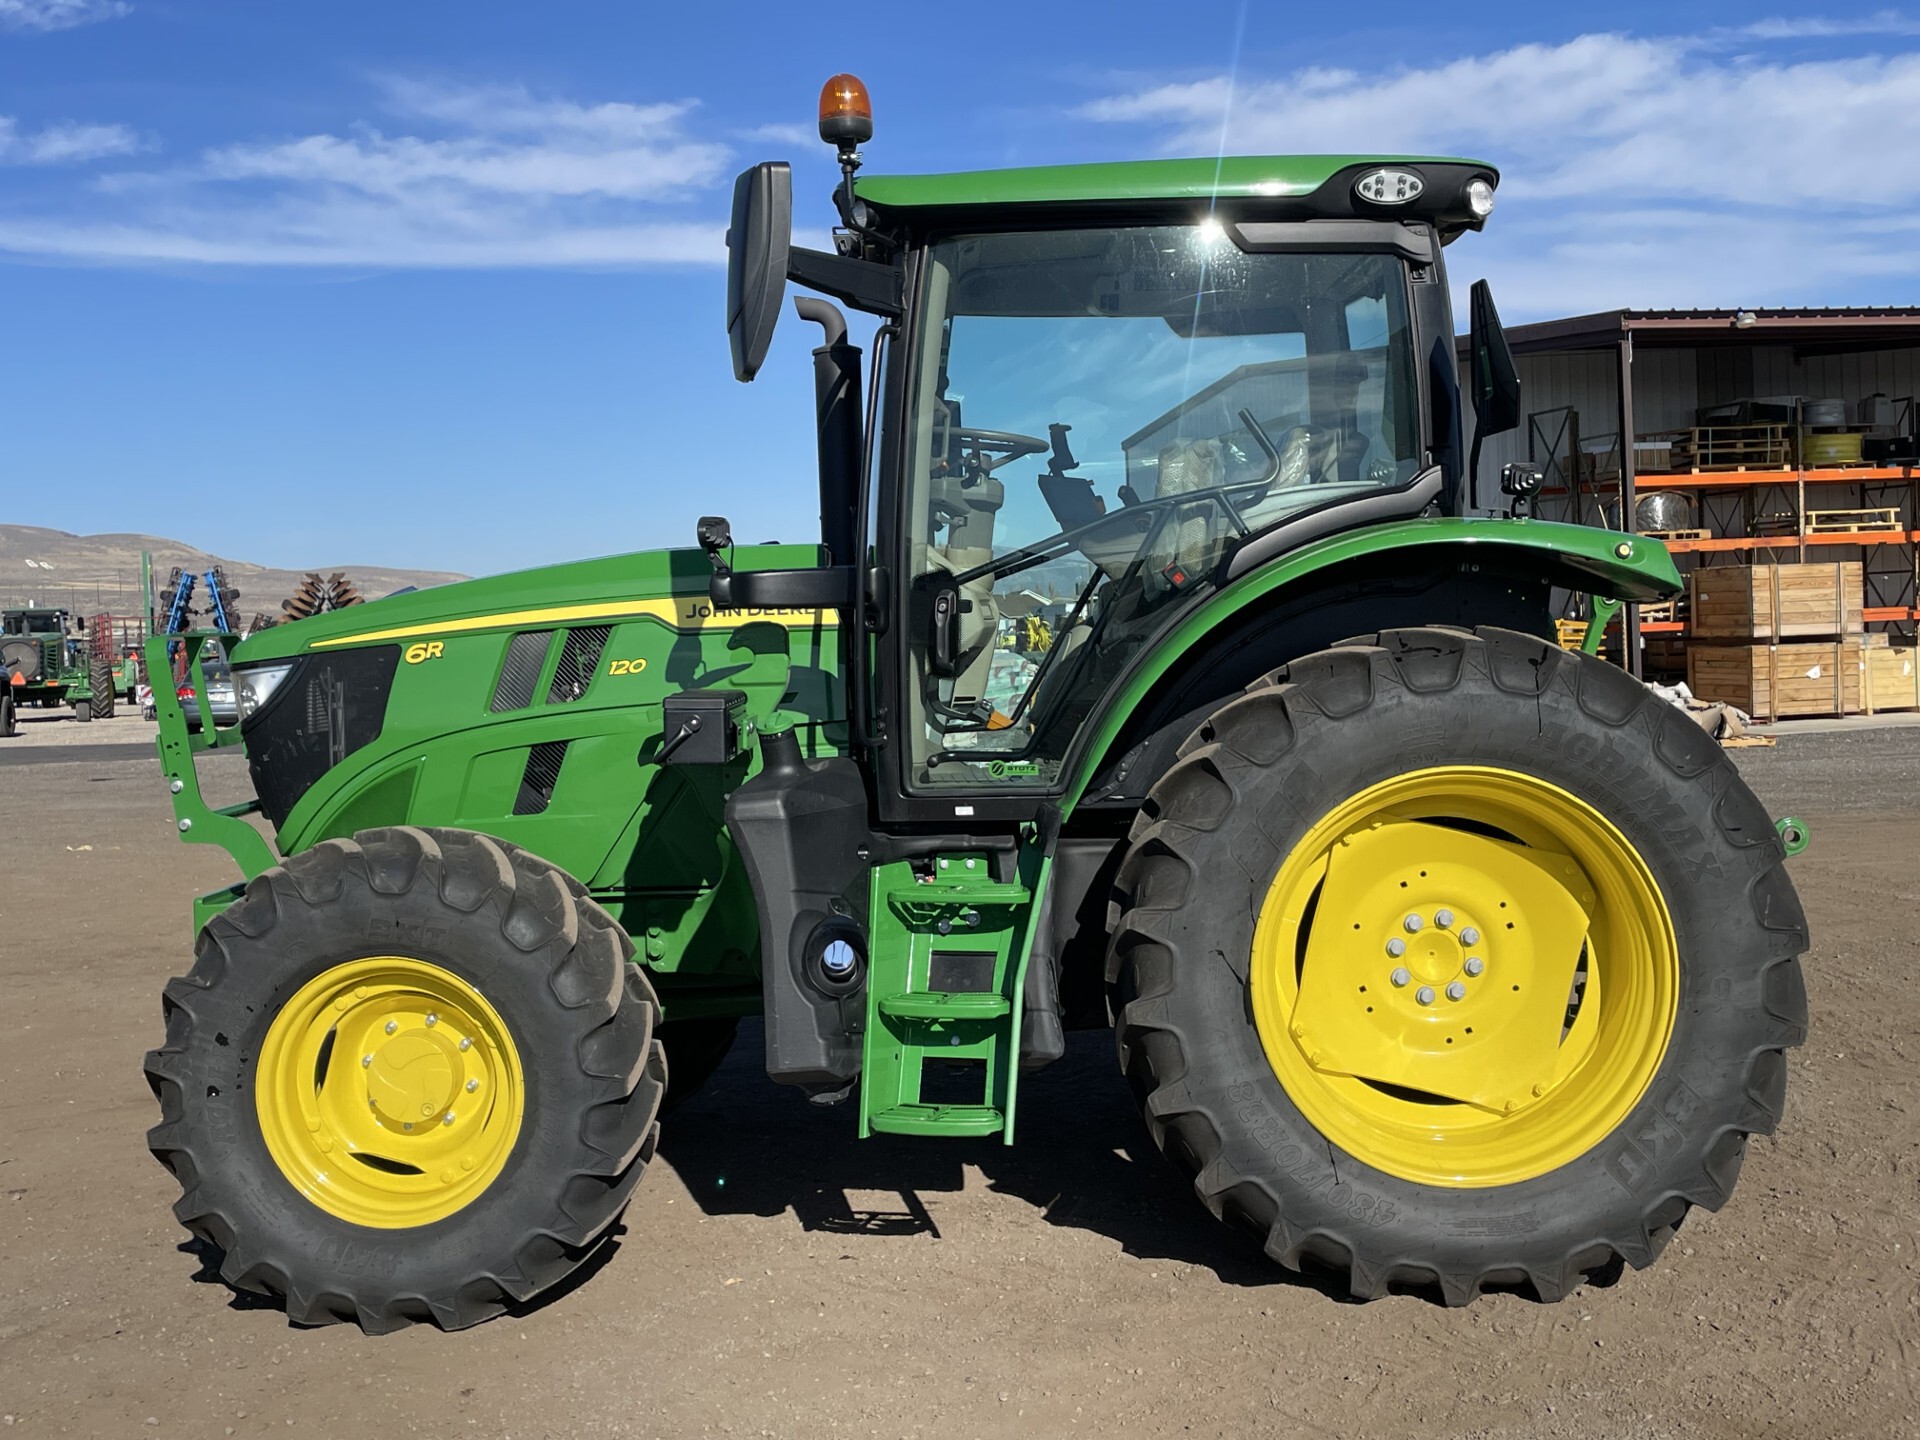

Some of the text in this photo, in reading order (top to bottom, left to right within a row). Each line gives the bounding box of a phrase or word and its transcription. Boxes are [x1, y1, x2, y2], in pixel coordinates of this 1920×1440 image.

[686, 604, 742, 619] JOHN
[405, 641, 444, 664] 6R
[608, 658, 647, 676] 120
[1527, 722, 1724, 884] AGRIMAX
[1227, 1081, 1396, 1228] 480/70R38
